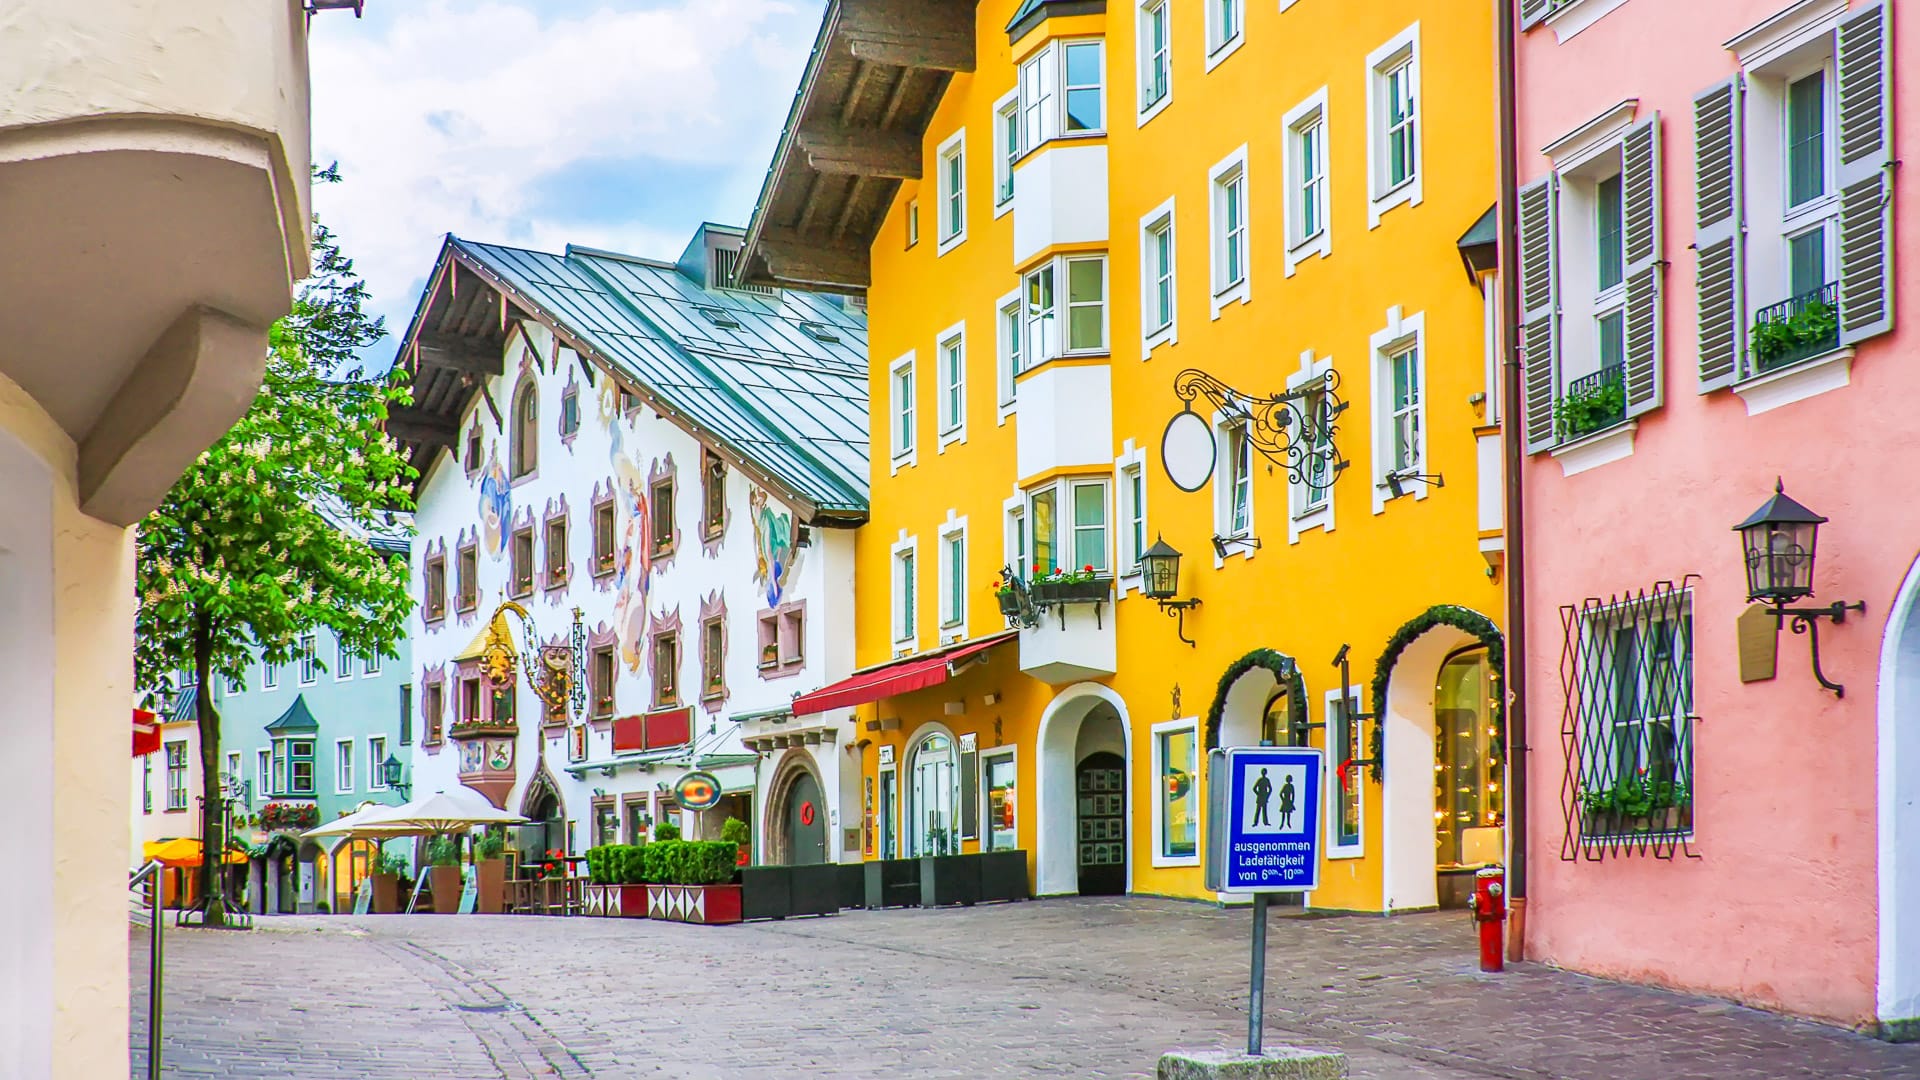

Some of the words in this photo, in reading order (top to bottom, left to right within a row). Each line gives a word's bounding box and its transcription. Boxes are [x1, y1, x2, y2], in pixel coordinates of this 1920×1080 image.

[1234, 842, 1310, 854] ausgenommen
[1239, 855, 1304, 868] Ladetätigkeit
[1239, 872, 1257, 880] von
